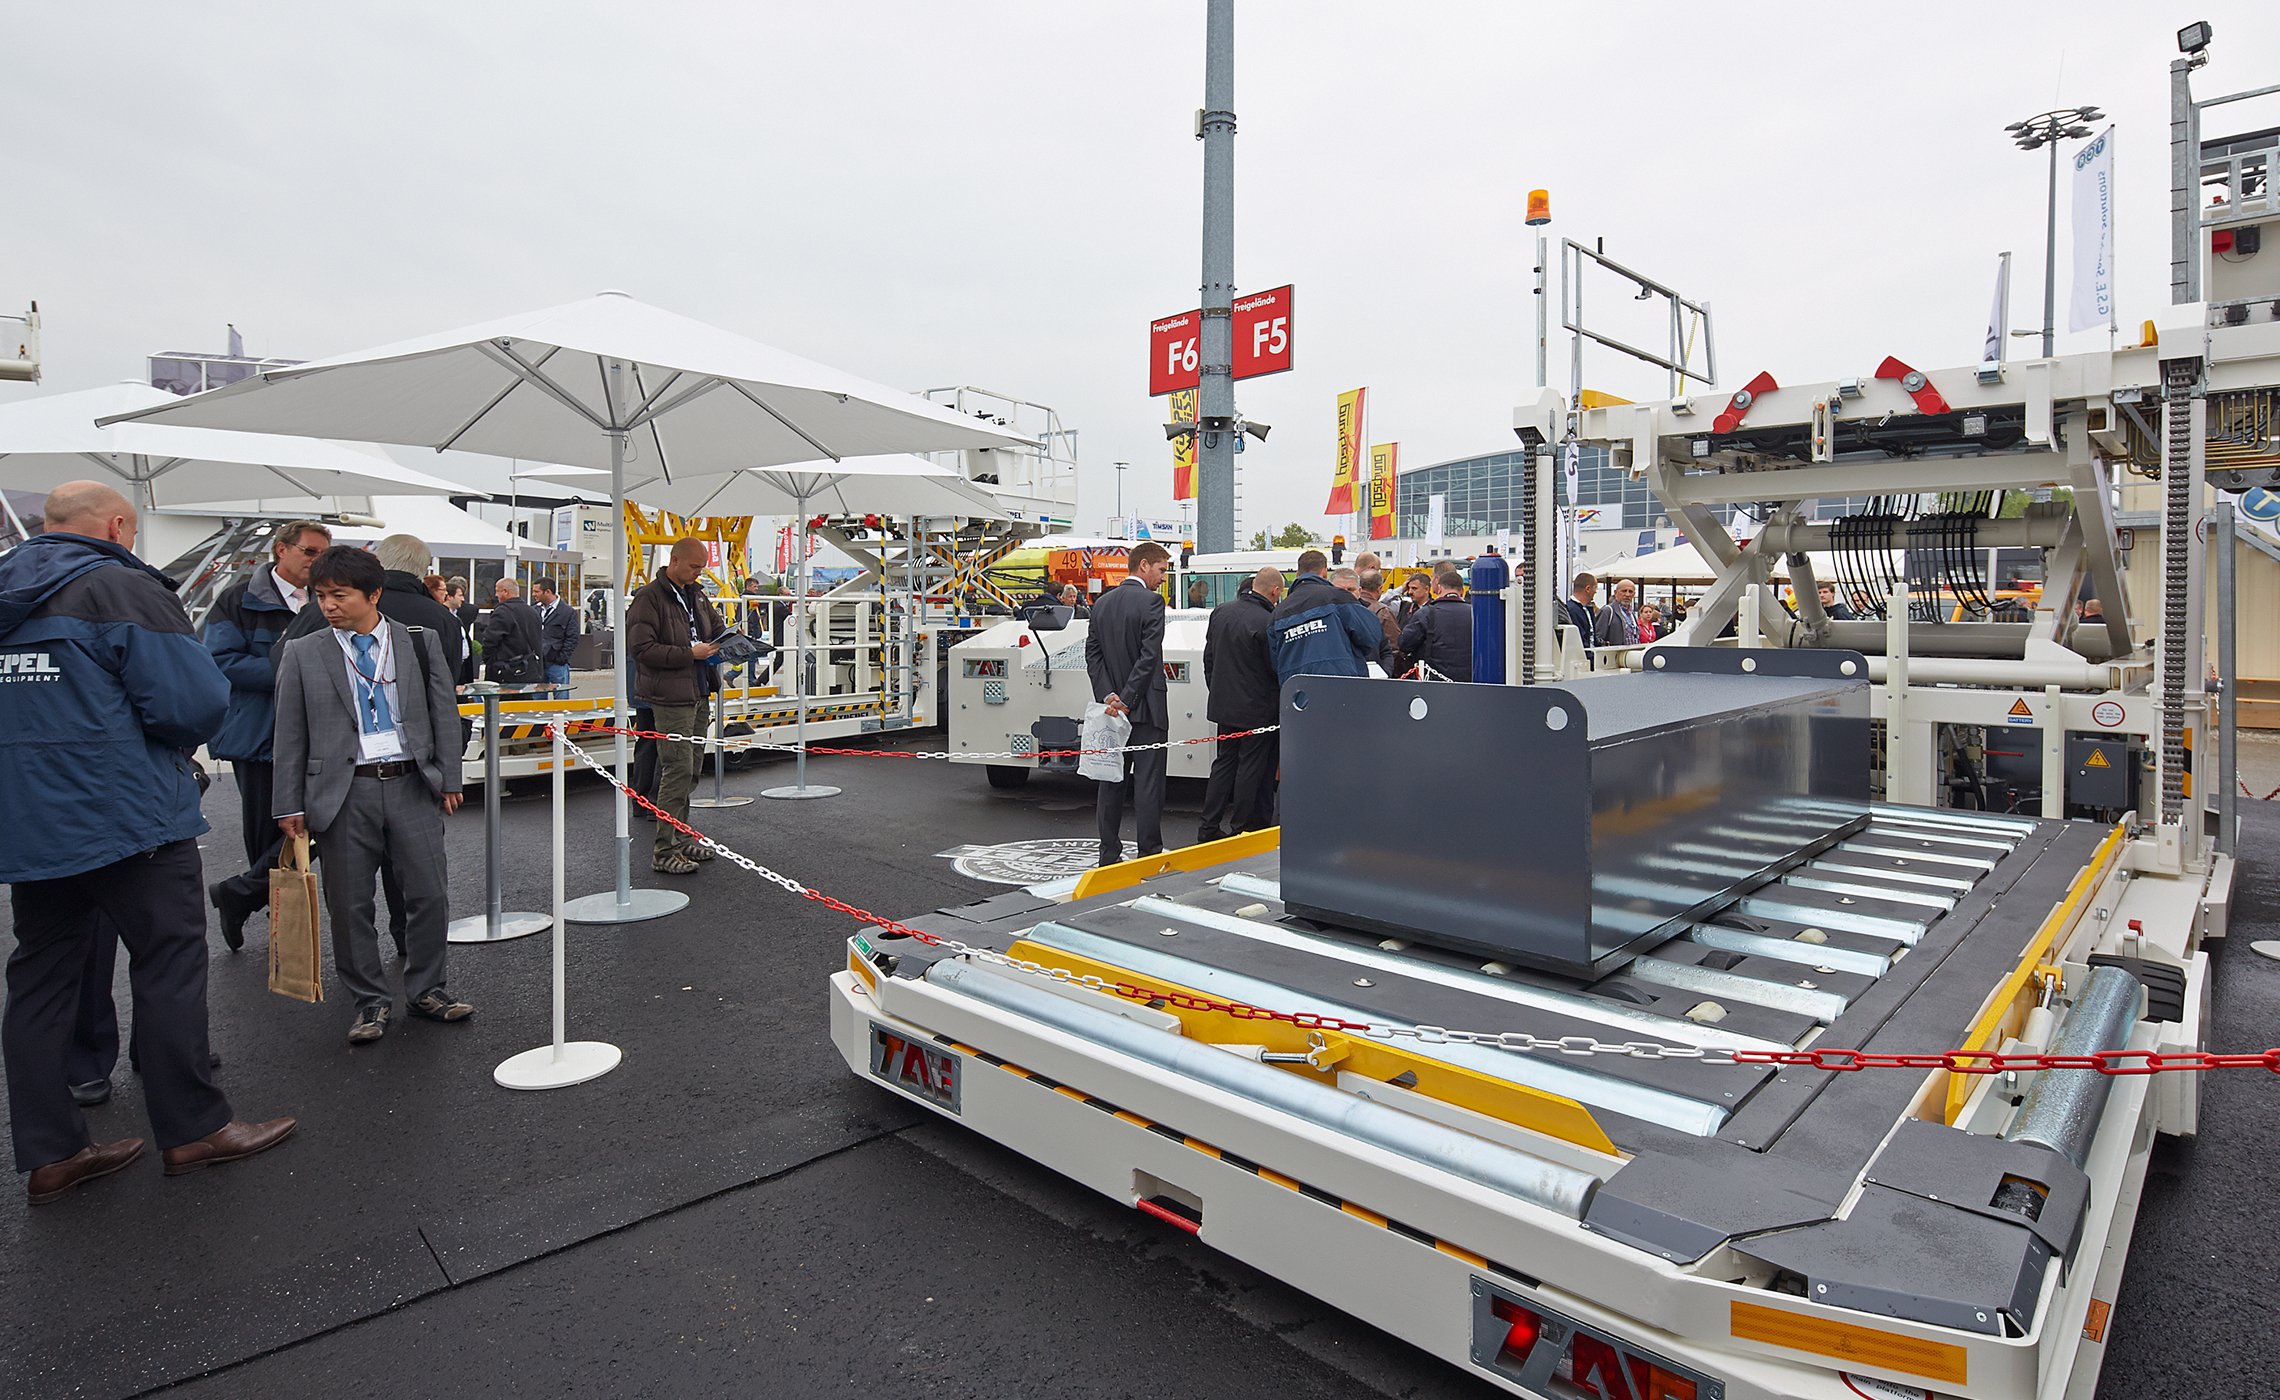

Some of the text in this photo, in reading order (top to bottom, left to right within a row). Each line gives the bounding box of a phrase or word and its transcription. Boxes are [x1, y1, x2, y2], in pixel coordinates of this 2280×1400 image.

[1233, 294, 1276, 313] Freigelände
[1152, 316, 1189, 333] Freigelände
[1253, 316, 1287, 358] F5
[1168, 337, 1199, 375] F6
[1062, 552, 1078, 568] 49
[1283, 619, 1327, 640] TREPEL
